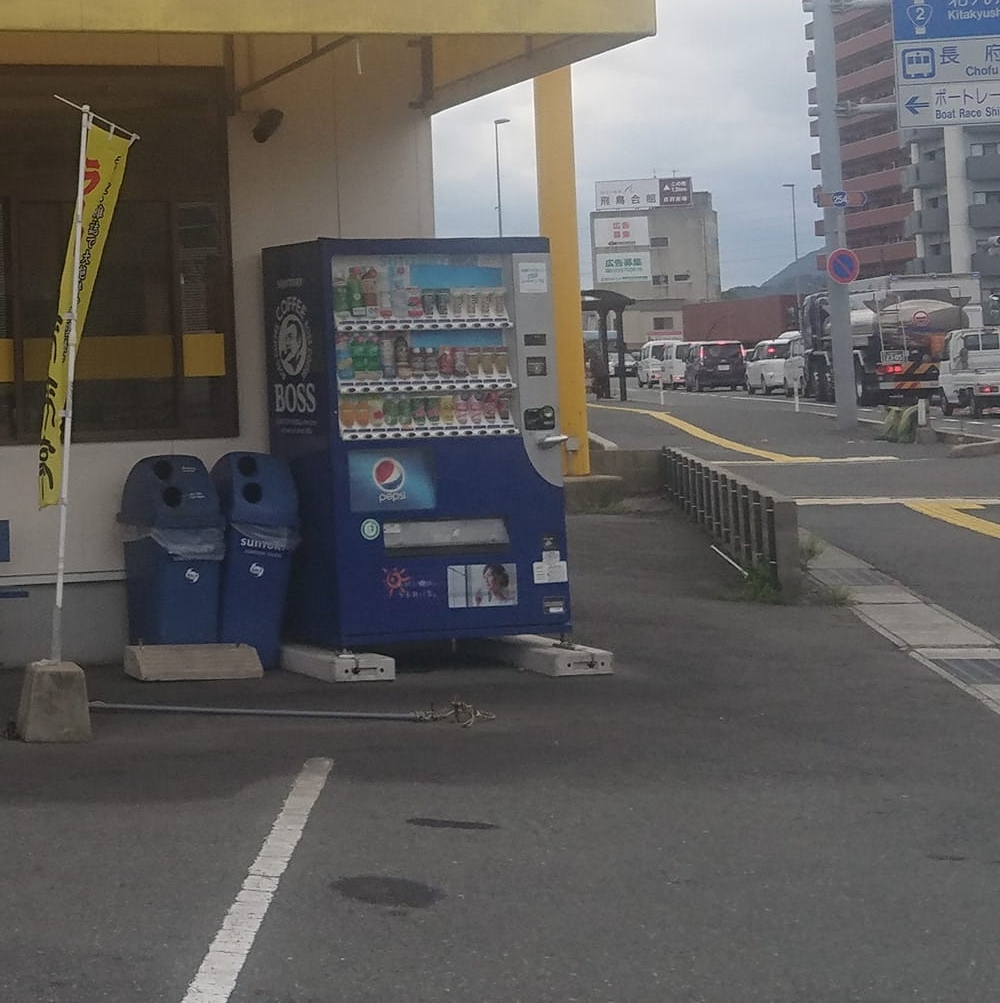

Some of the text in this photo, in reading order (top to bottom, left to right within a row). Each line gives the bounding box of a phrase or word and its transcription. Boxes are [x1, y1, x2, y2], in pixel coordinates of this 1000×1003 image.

[915, 7, 926, 21] 2
[965, 65, 999, 77] Chofu
[935, 108, 956, 120] Boat
[959, 107, 982, 119] Race
[276, 296, 308, 321] COFFEE
[274, 383, 317, 413] BOSS
[378, 490, 407, 503] pepsi
